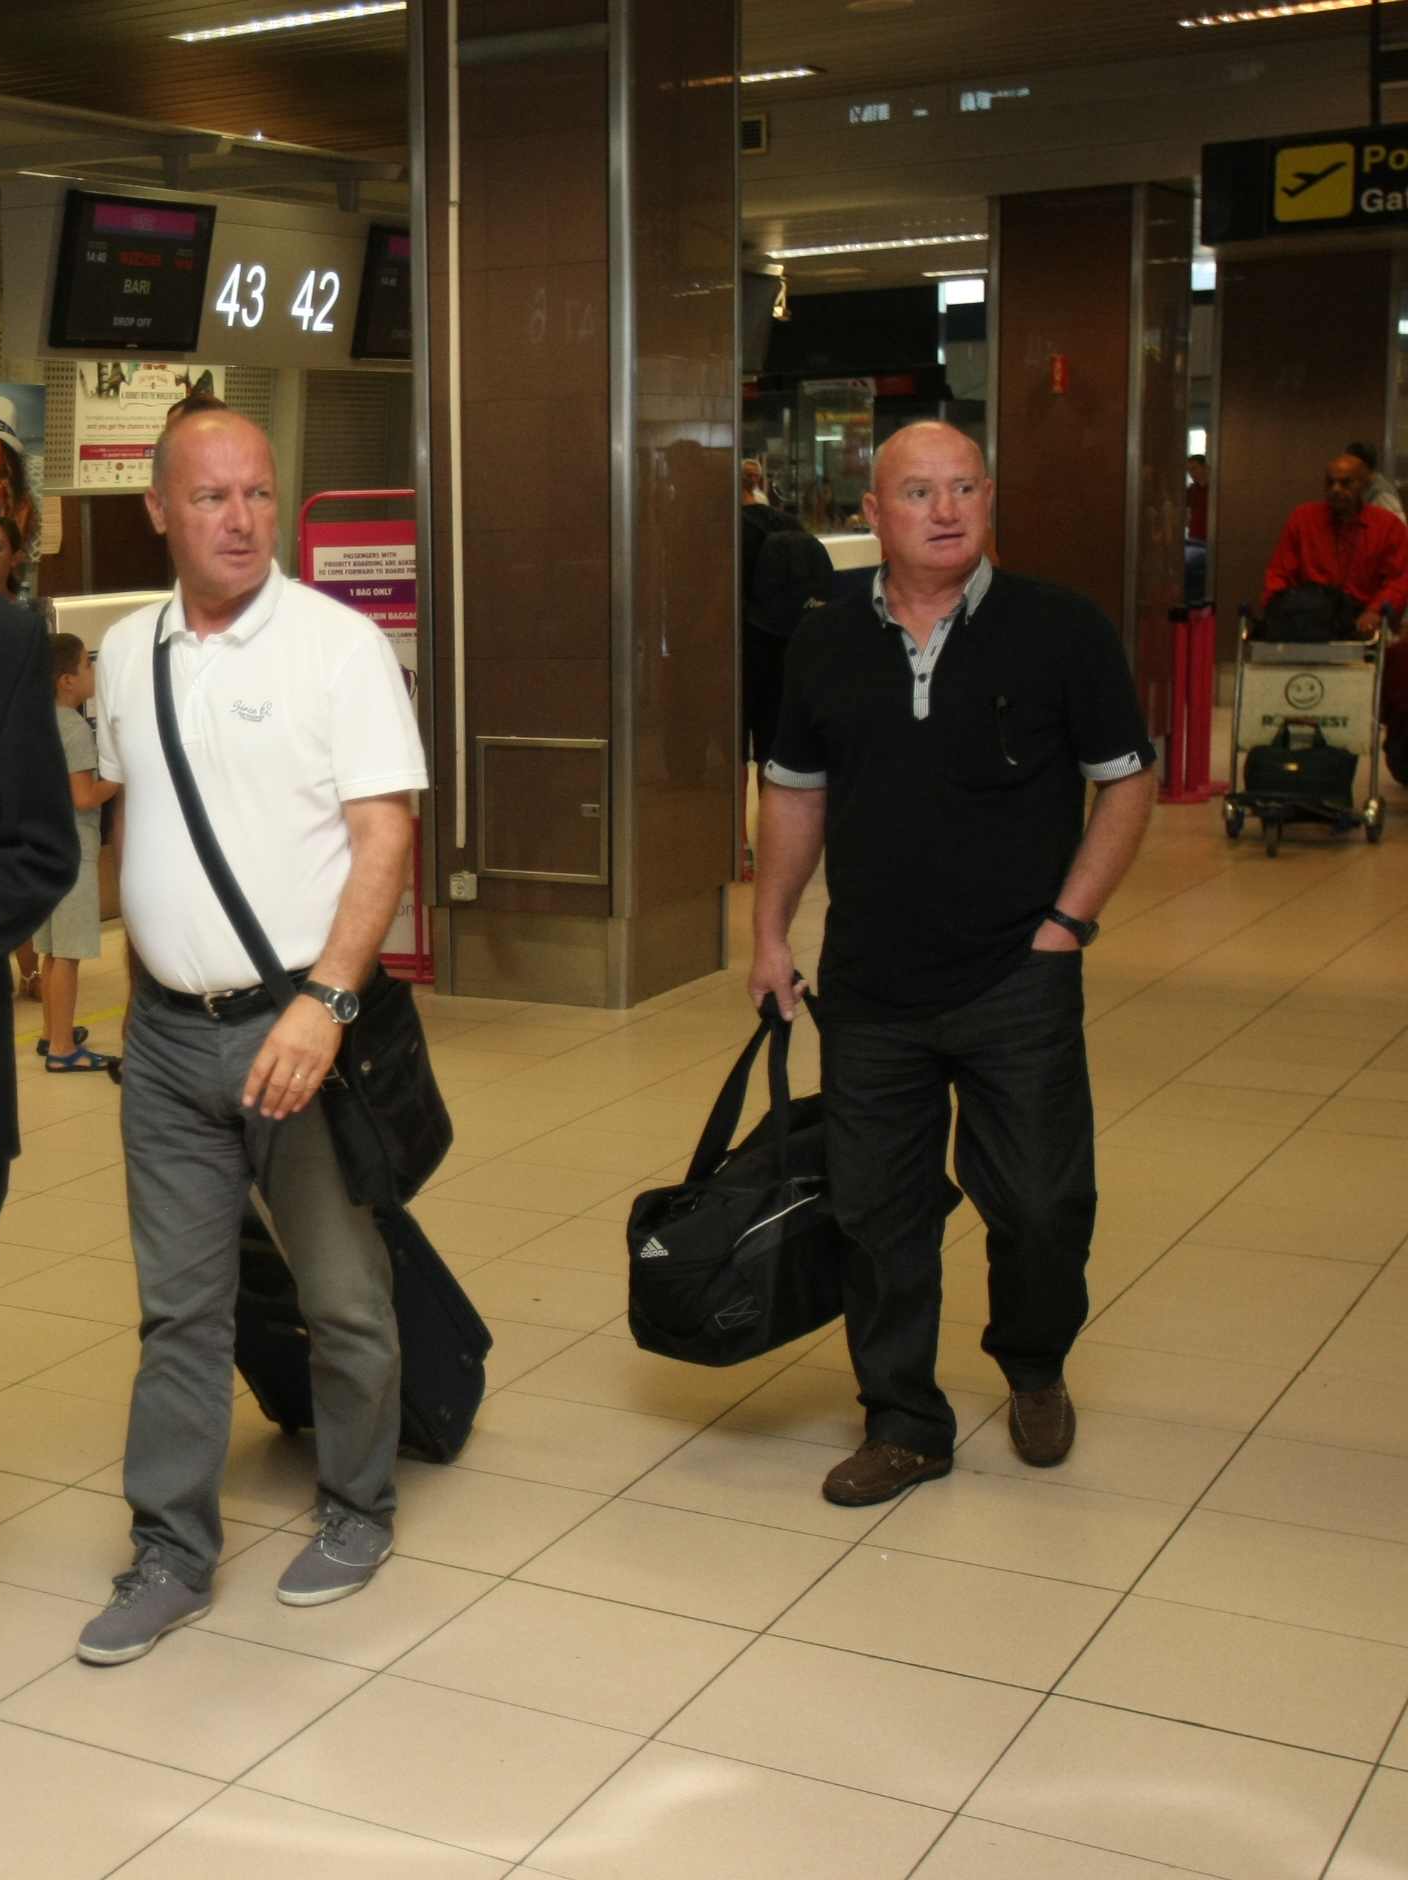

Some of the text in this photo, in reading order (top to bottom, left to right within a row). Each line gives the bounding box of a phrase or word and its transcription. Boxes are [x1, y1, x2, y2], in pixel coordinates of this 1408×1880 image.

[1363, 144, 1408, 174] Po
[1360, 187, 1408, 214] Ga
[123, 279, 151, 295] BARI
[215, 263, 340, 332] 43 42
[113, 316, 152, 328] DROP OFF
[343, 552, 380, 560] PASSENGERS
[349, 587, 393, 596] 1 BAG ONLY
[640, 1249, 669, 1258] adidas
